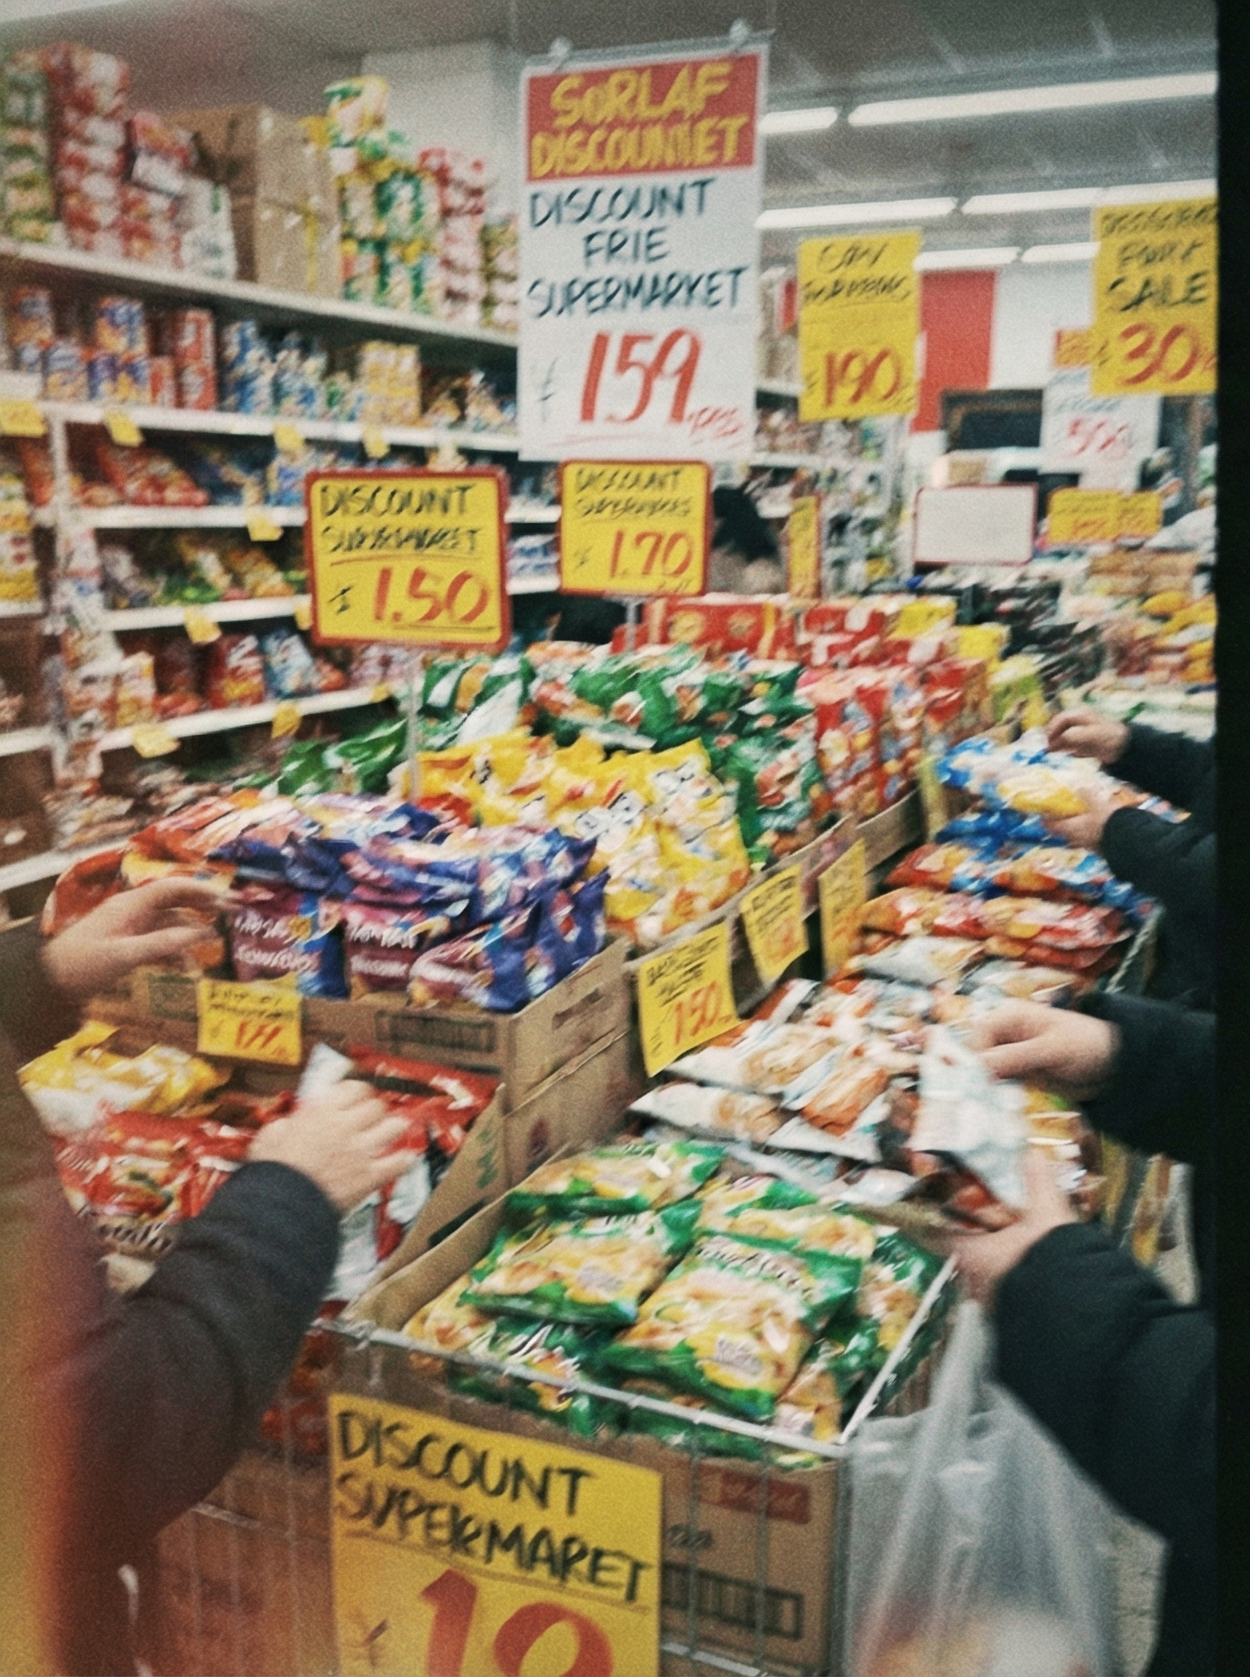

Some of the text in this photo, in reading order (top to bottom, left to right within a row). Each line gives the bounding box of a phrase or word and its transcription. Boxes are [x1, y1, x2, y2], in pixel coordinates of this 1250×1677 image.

[530, 177, 718, 228] DISCOUNT
[579, 327, 705, 423] 159
[1115, 321, 1201, 387] 30
[320, 484, 476, 518] DISCOUNT
[373, 566, 490, 624] 1.50
[336, 1410, 596, 1517] DISCOUNT
